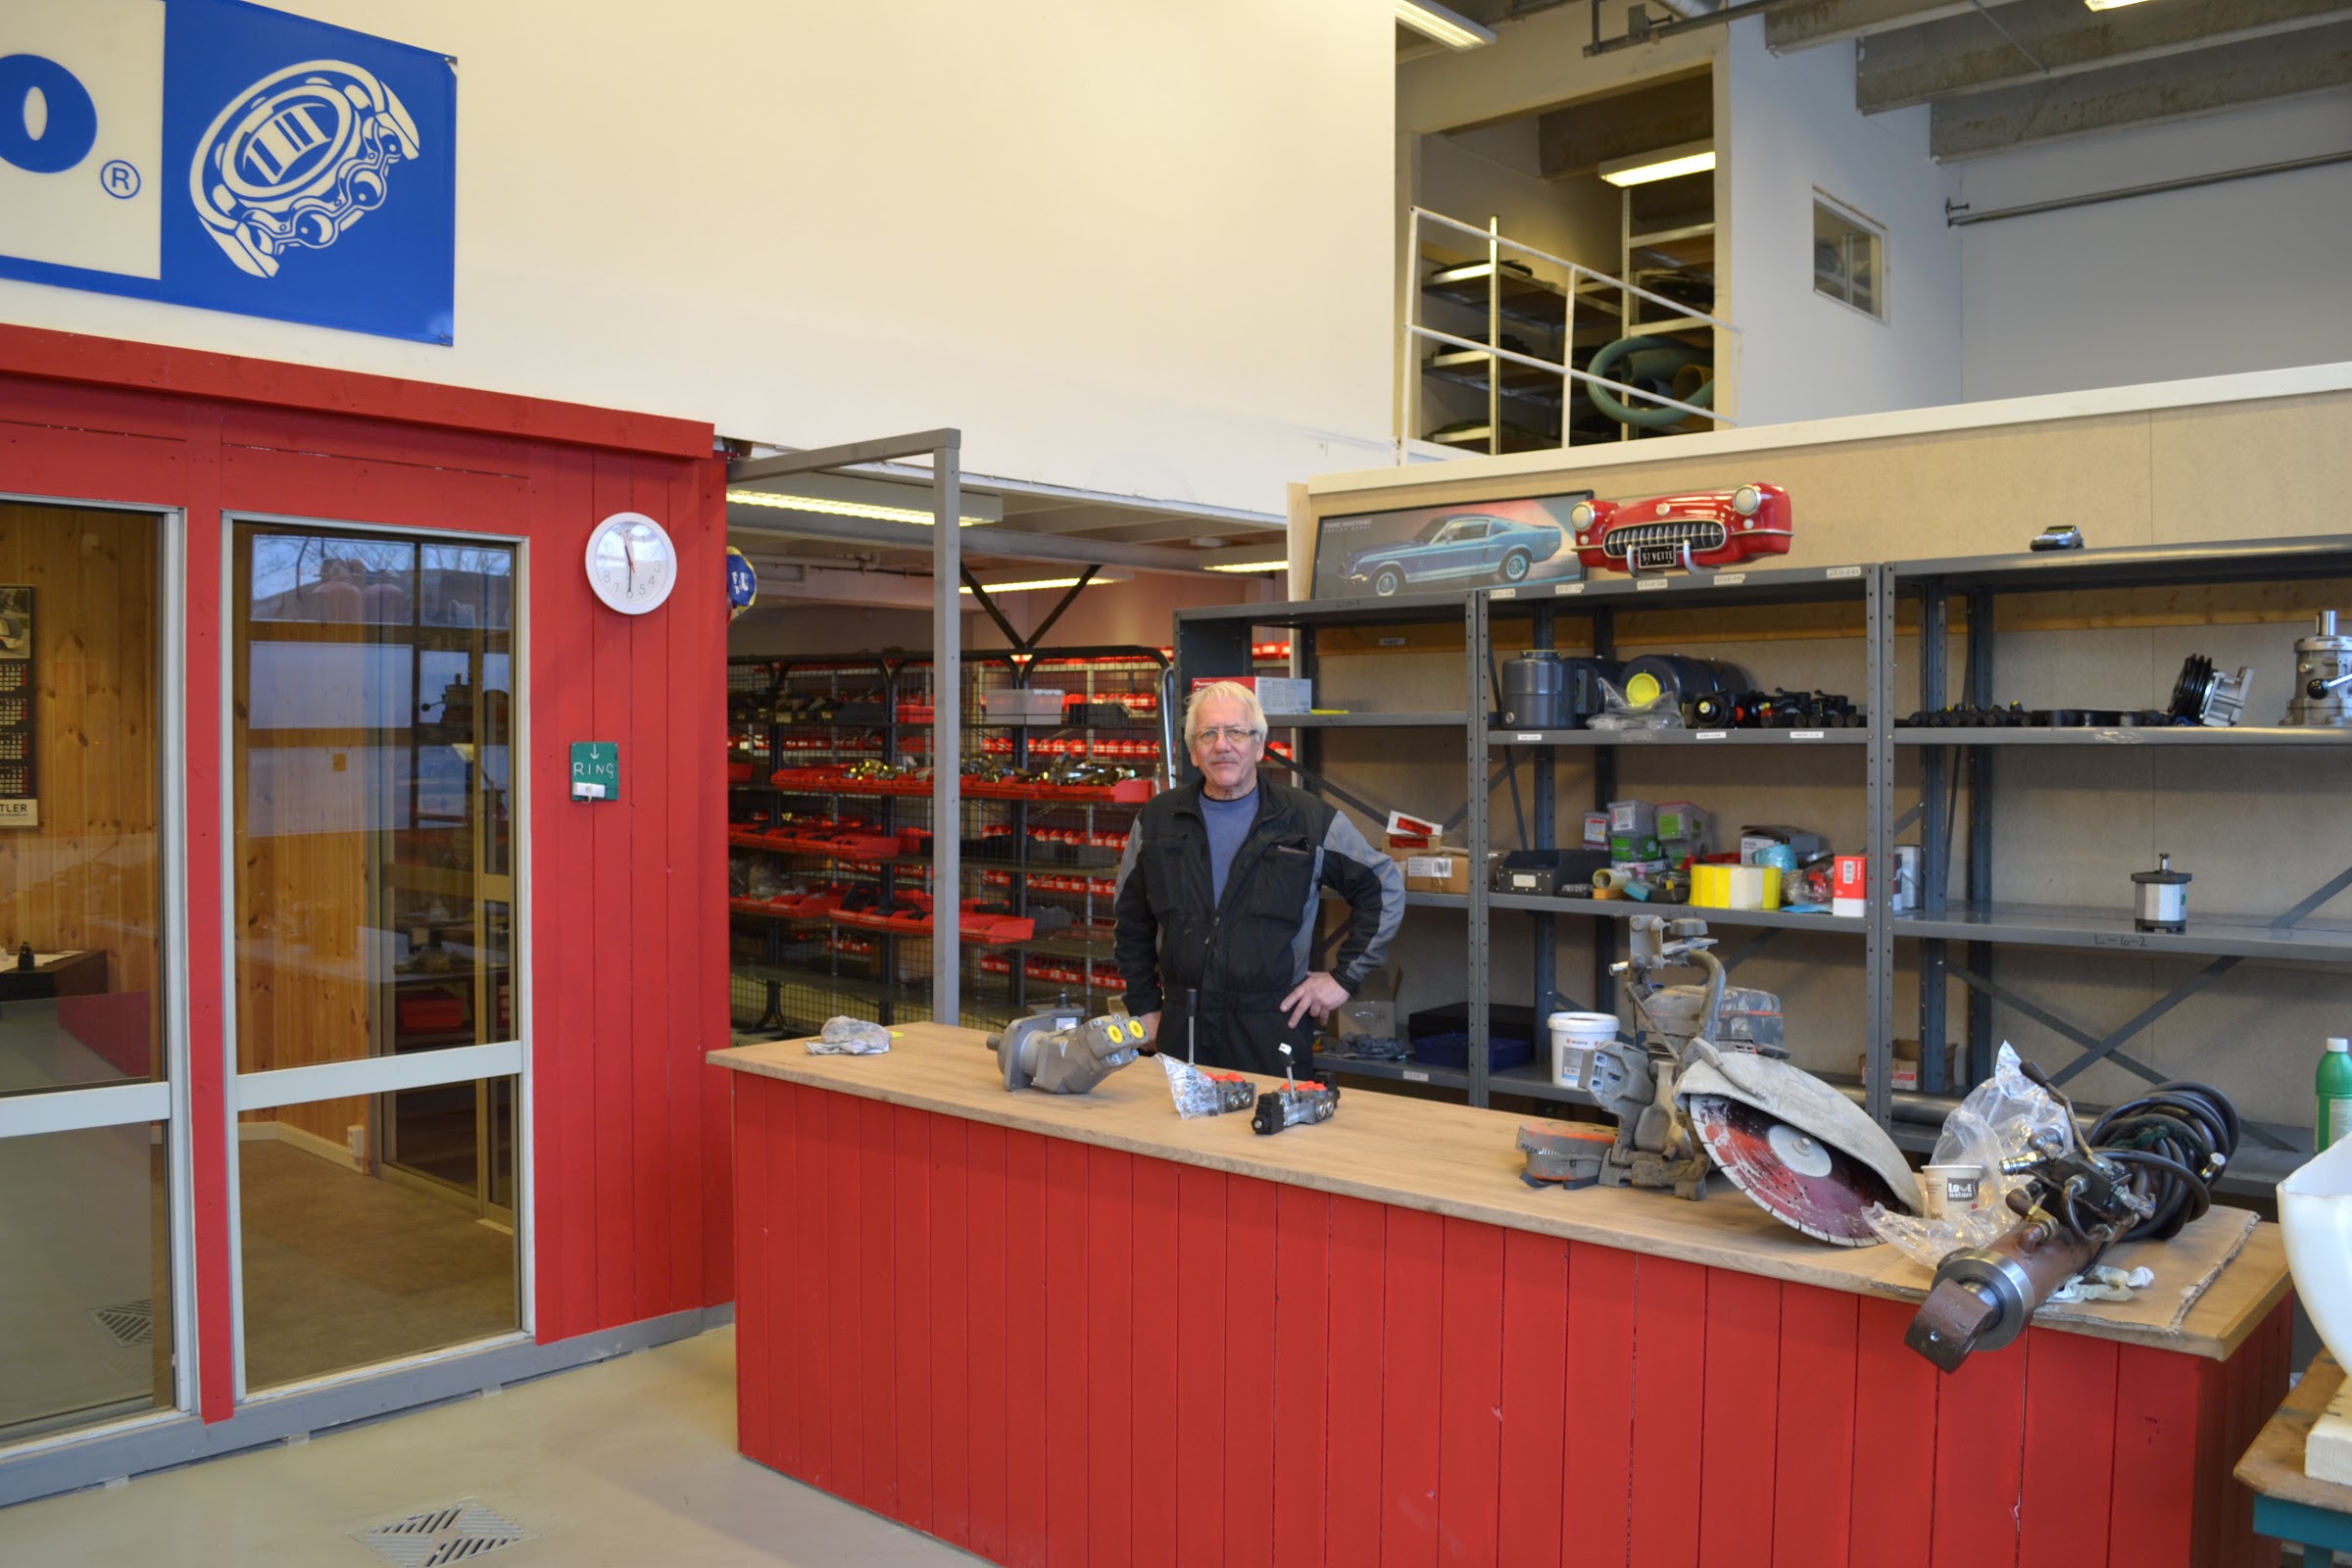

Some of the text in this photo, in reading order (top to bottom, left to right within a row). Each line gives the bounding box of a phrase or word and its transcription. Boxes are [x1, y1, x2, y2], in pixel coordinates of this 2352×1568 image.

[1642, 552, 1673, 562] 57 VETTE
[603, 570, 612, 583] 8
[648, 574, 656, 587] 4
[613, 581, 620, 593] 7
[638, 583, 647, 596] 5
[573, 761, 613, 779] RING
[2094, 933, 2147, 948] L-6-2
